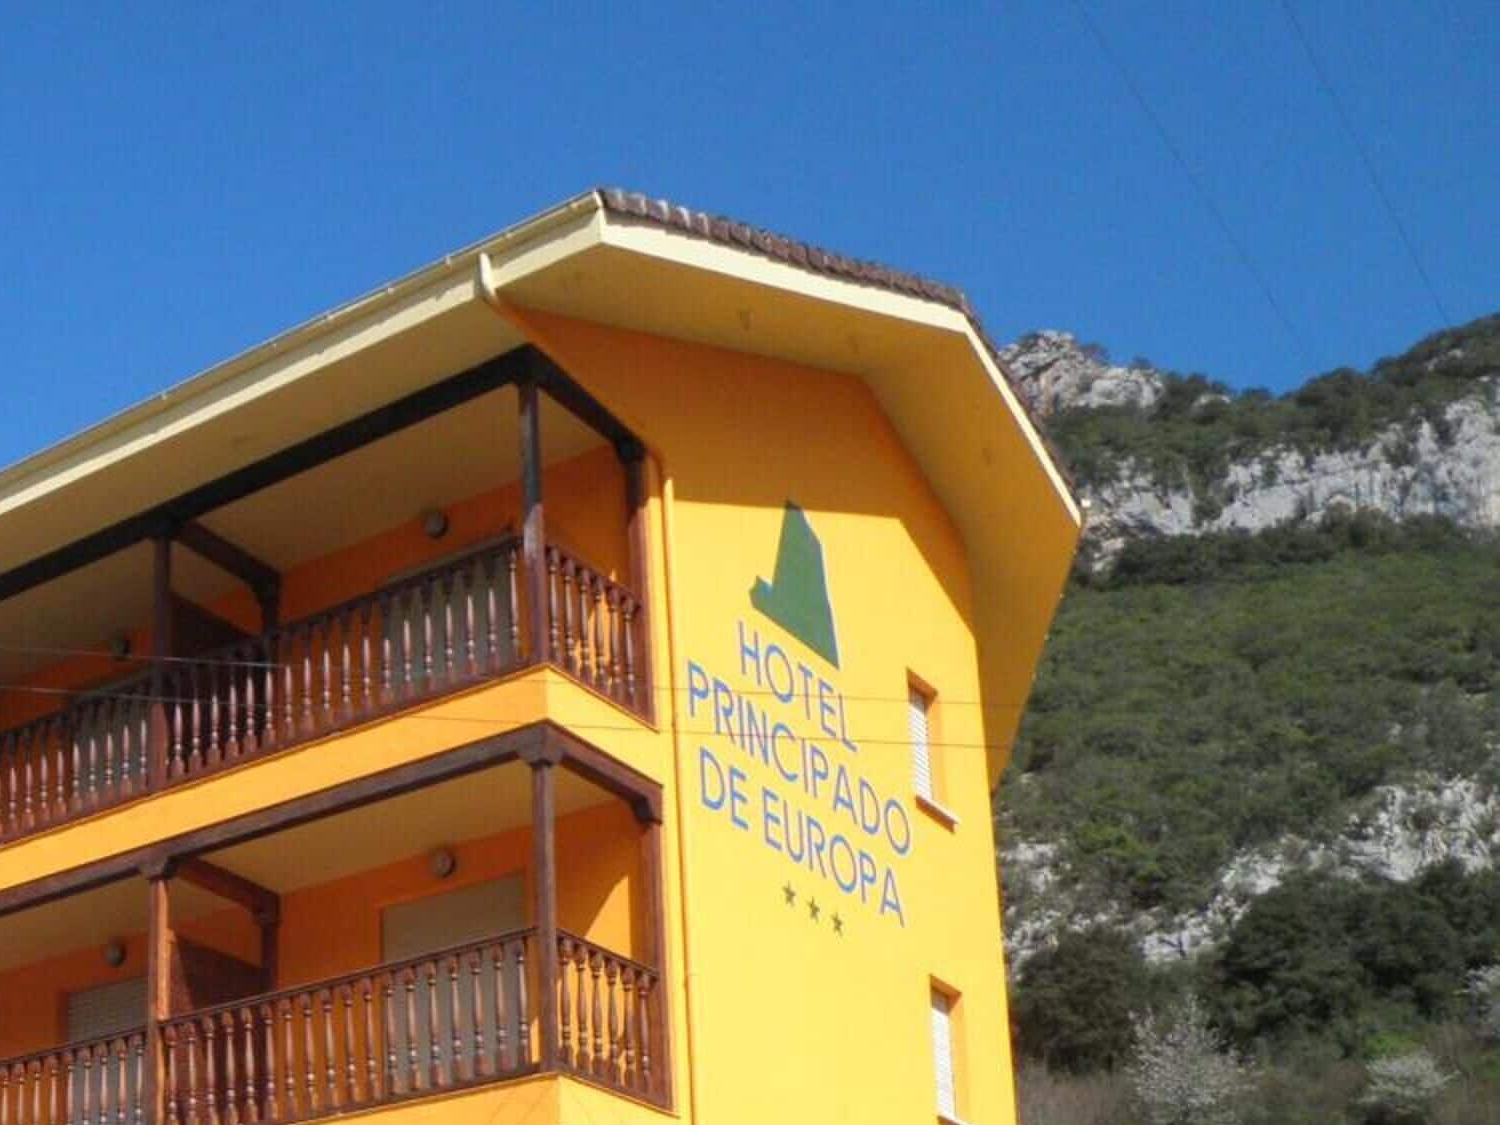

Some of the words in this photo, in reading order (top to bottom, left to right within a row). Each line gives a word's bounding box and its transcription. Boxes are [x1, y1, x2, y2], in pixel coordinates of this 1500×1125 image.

[687, 661, 910, 856] PRINCIPADO
[739, 621, 857, 752] HOTEL
[699, 747, 749, 831] DE
[762, 787, 905, 928] EUROPA
